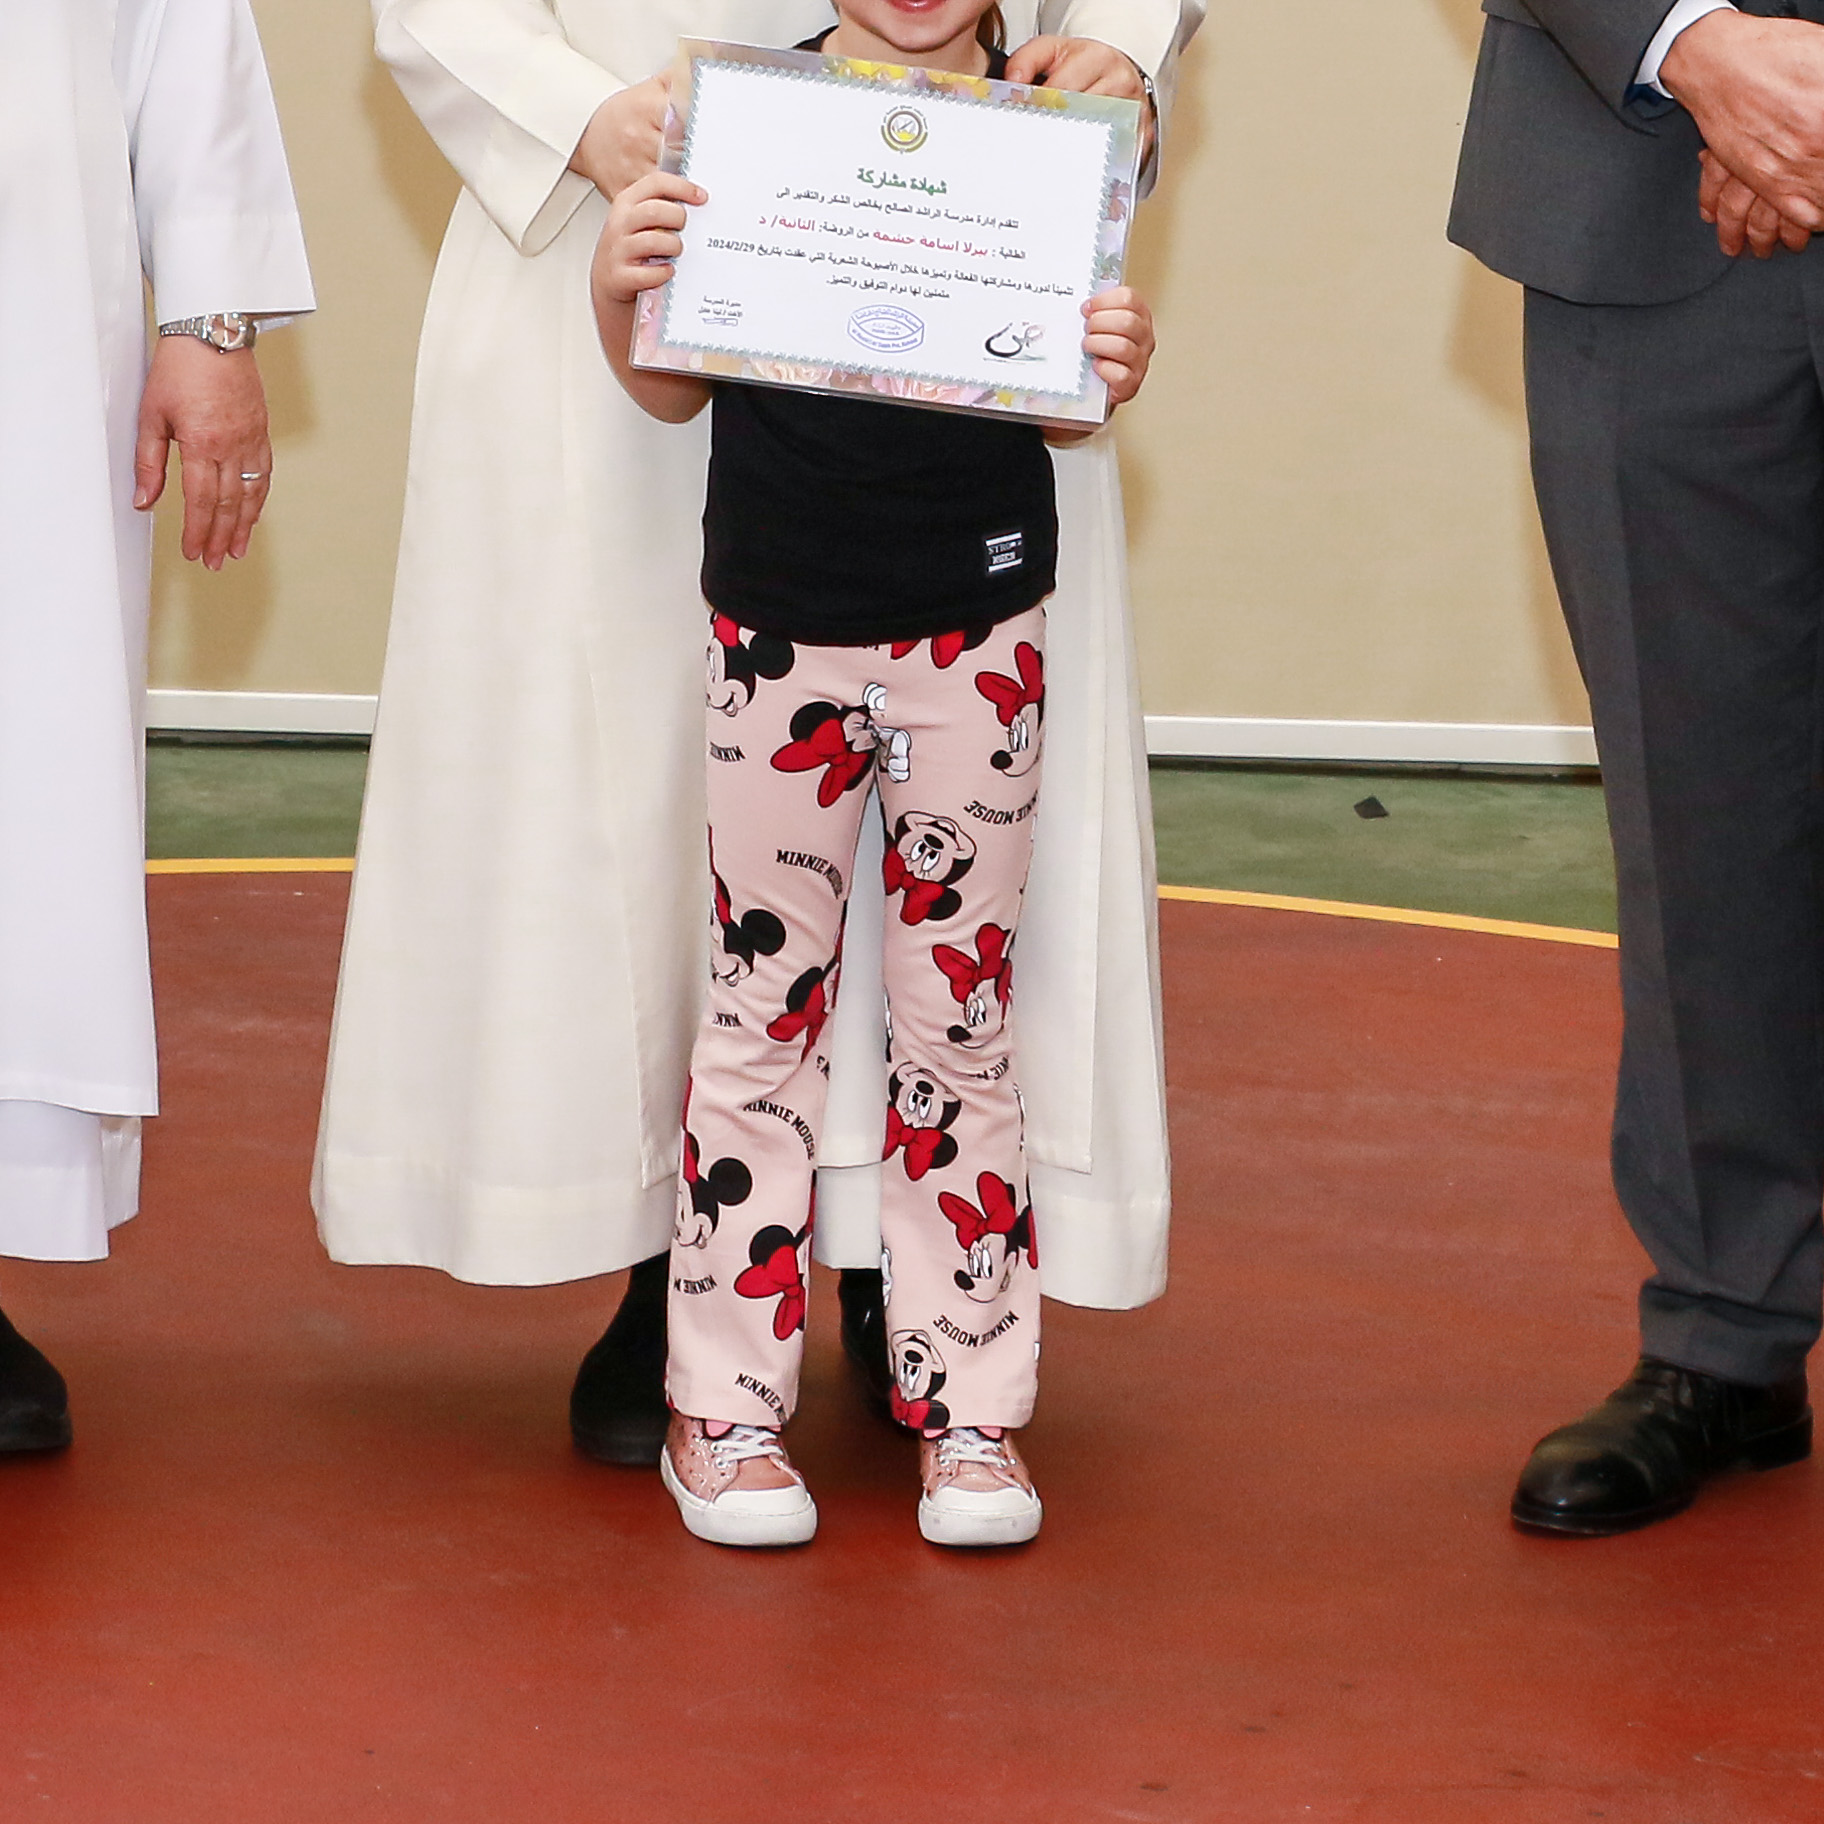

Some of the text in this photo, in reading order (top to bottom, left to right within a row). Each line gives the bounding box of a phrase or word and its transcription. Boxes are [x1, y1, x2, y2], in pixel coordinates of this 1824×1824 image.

[857, 168, 947, 196] شهادة مشاركة
[827, 194, 851, 205] الشكر
[884, 202, 913, 215] الصالح
[943, 208, 974, 223] مدرسة
[857, 228, 870, 239] من
[707, 237, 755, 253] 2024/2/29
[963, 800, 1015, 825] MOUSE
[776, 849, 829, 874] MINNIE
[743, 1099, 816, 1160] MINNIE MOUSE
[683, 1275, 718, 1294] MINNIE
[932, 1309, 1020, 1347] MINNIE MOUSE
[735, 1373, 784, 1409] MINNIE
